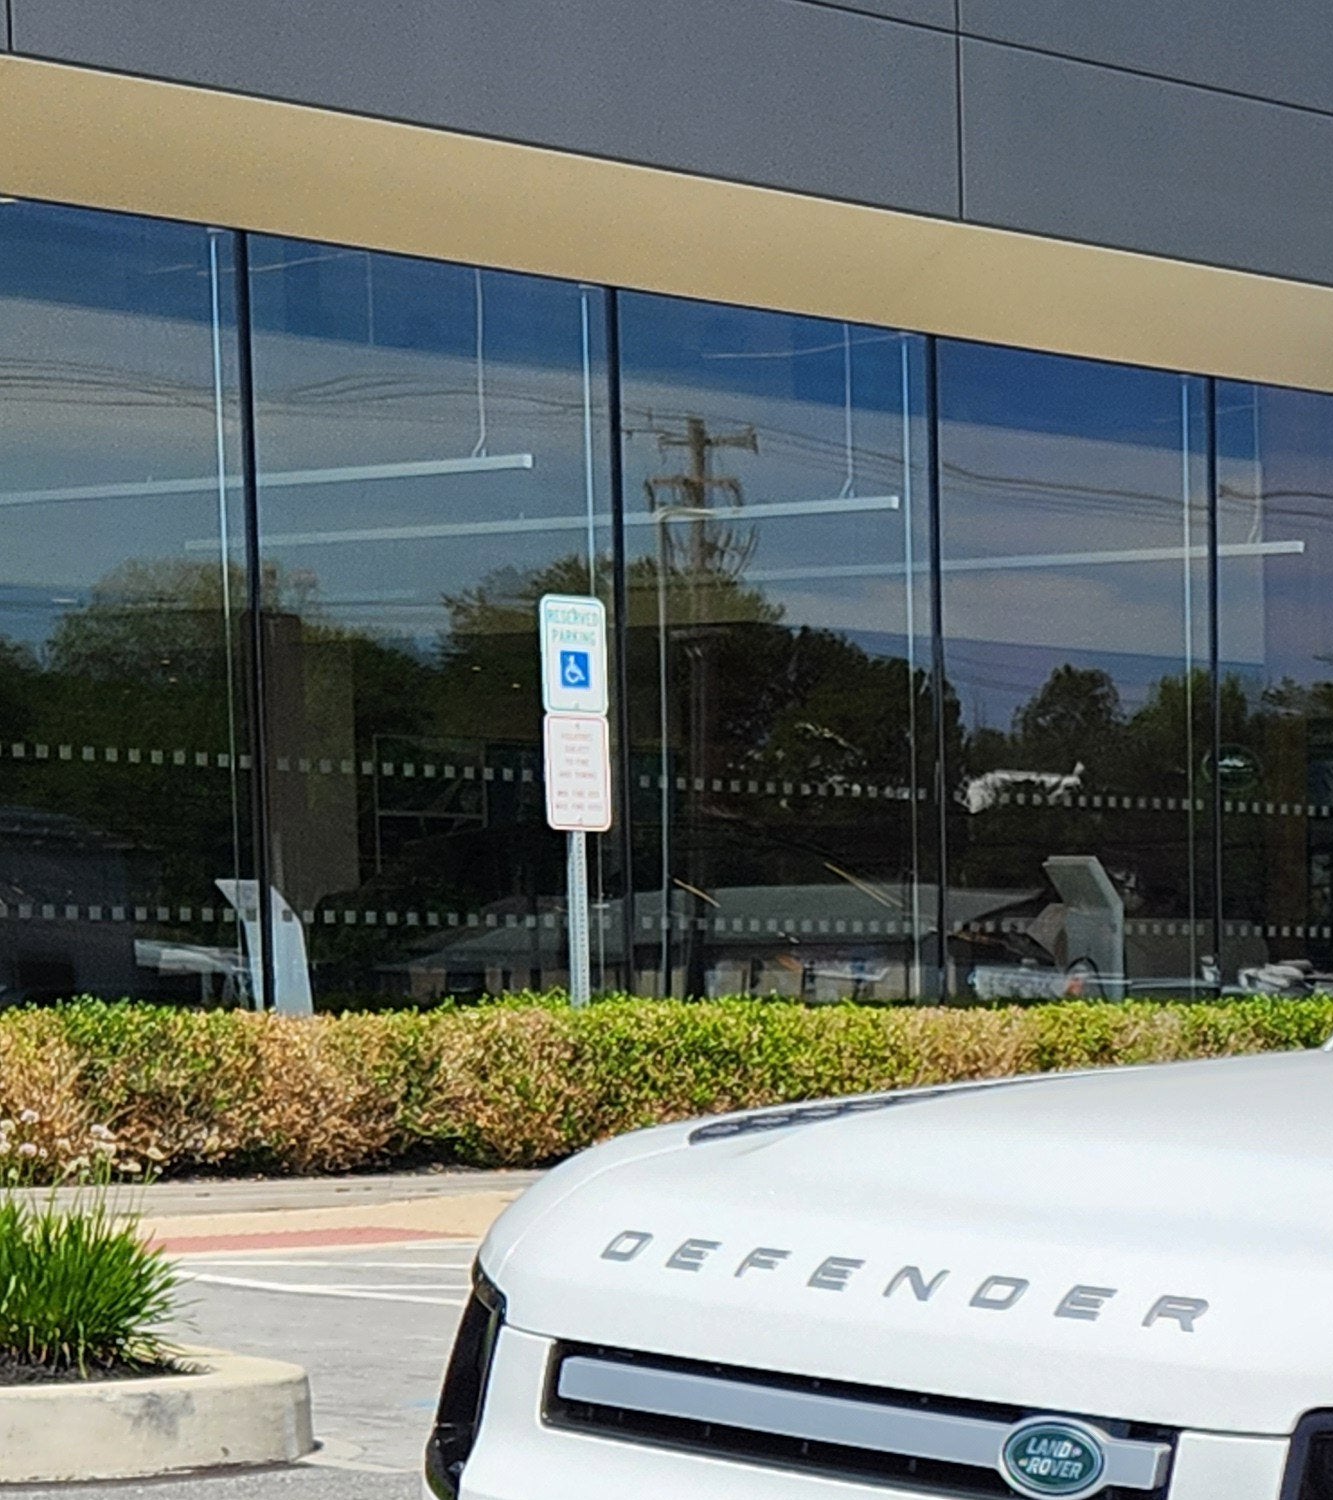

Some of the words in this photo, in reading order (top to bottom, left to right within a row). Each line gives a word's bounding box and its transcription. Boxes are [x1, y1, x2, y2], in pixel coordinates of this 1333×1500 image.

[552, 629, 596, 646] PARKING
[599, 1230, 1210, 1333] DEFENDER
[1026, 1437, 1073, 1458] LAND
[1026, 1457, 1083, 1479] ROVER
